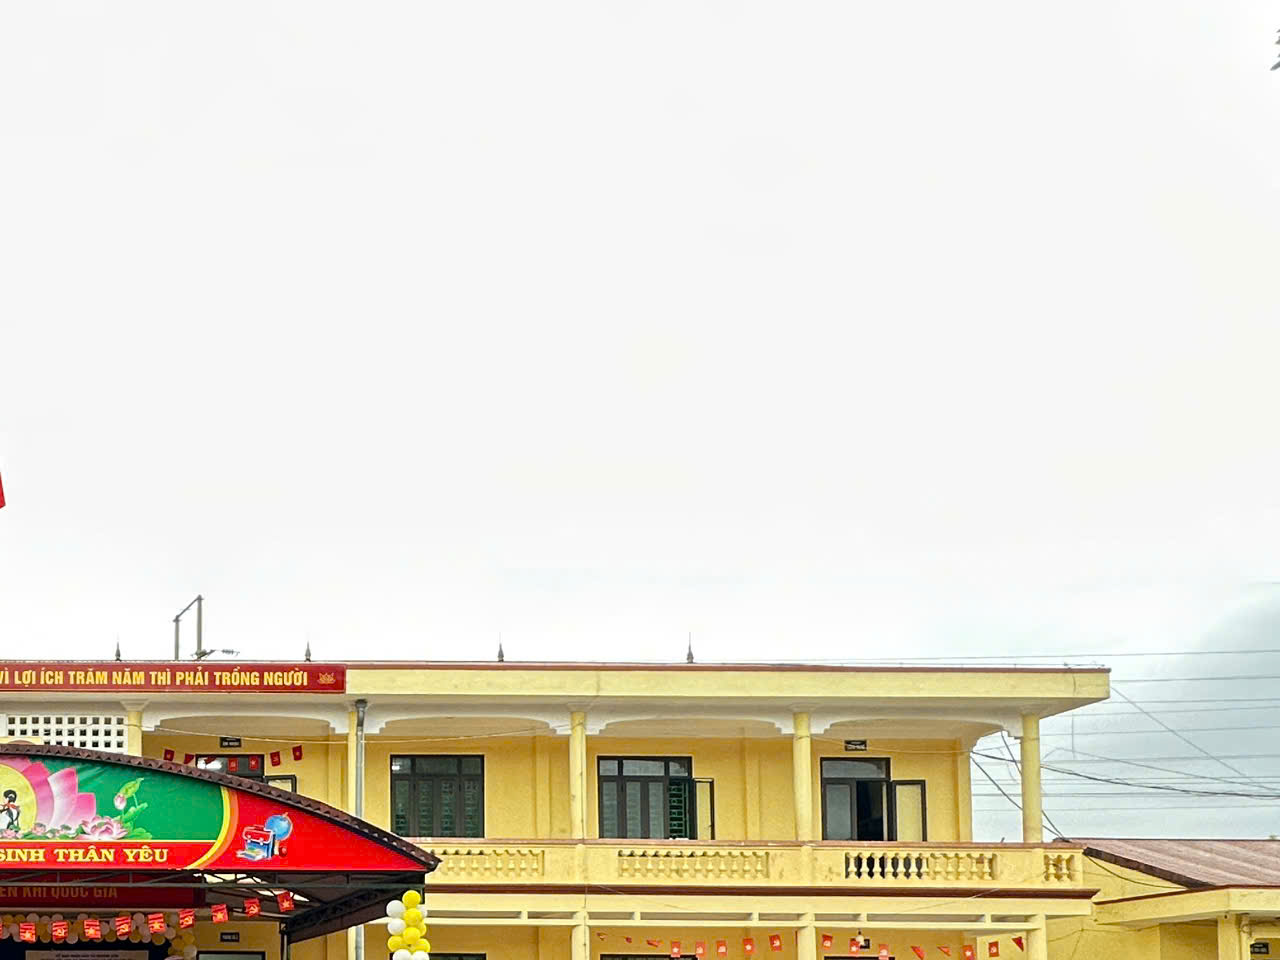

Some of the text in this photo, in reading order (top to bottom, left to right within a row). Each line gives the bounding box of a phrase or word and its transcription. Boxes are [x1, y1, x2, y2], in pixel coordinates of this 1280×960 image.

[14, 669, 36, 687] LỢI
[40, 667, 64, 684] ÍCH
[68, 667, 108, 684] TRĂM
[112, 667, 145, 684] NĂM
[150, 668, 172, 684] THÌ
[176, 666, 209, 685] PHẢI
[214, 665, 260, 685] TRỒNG
[263, 666, 308, 685] NGƯỜI
[54, 844, 115, 863] THÂN
[123, 844, 169, 863] YÊU
